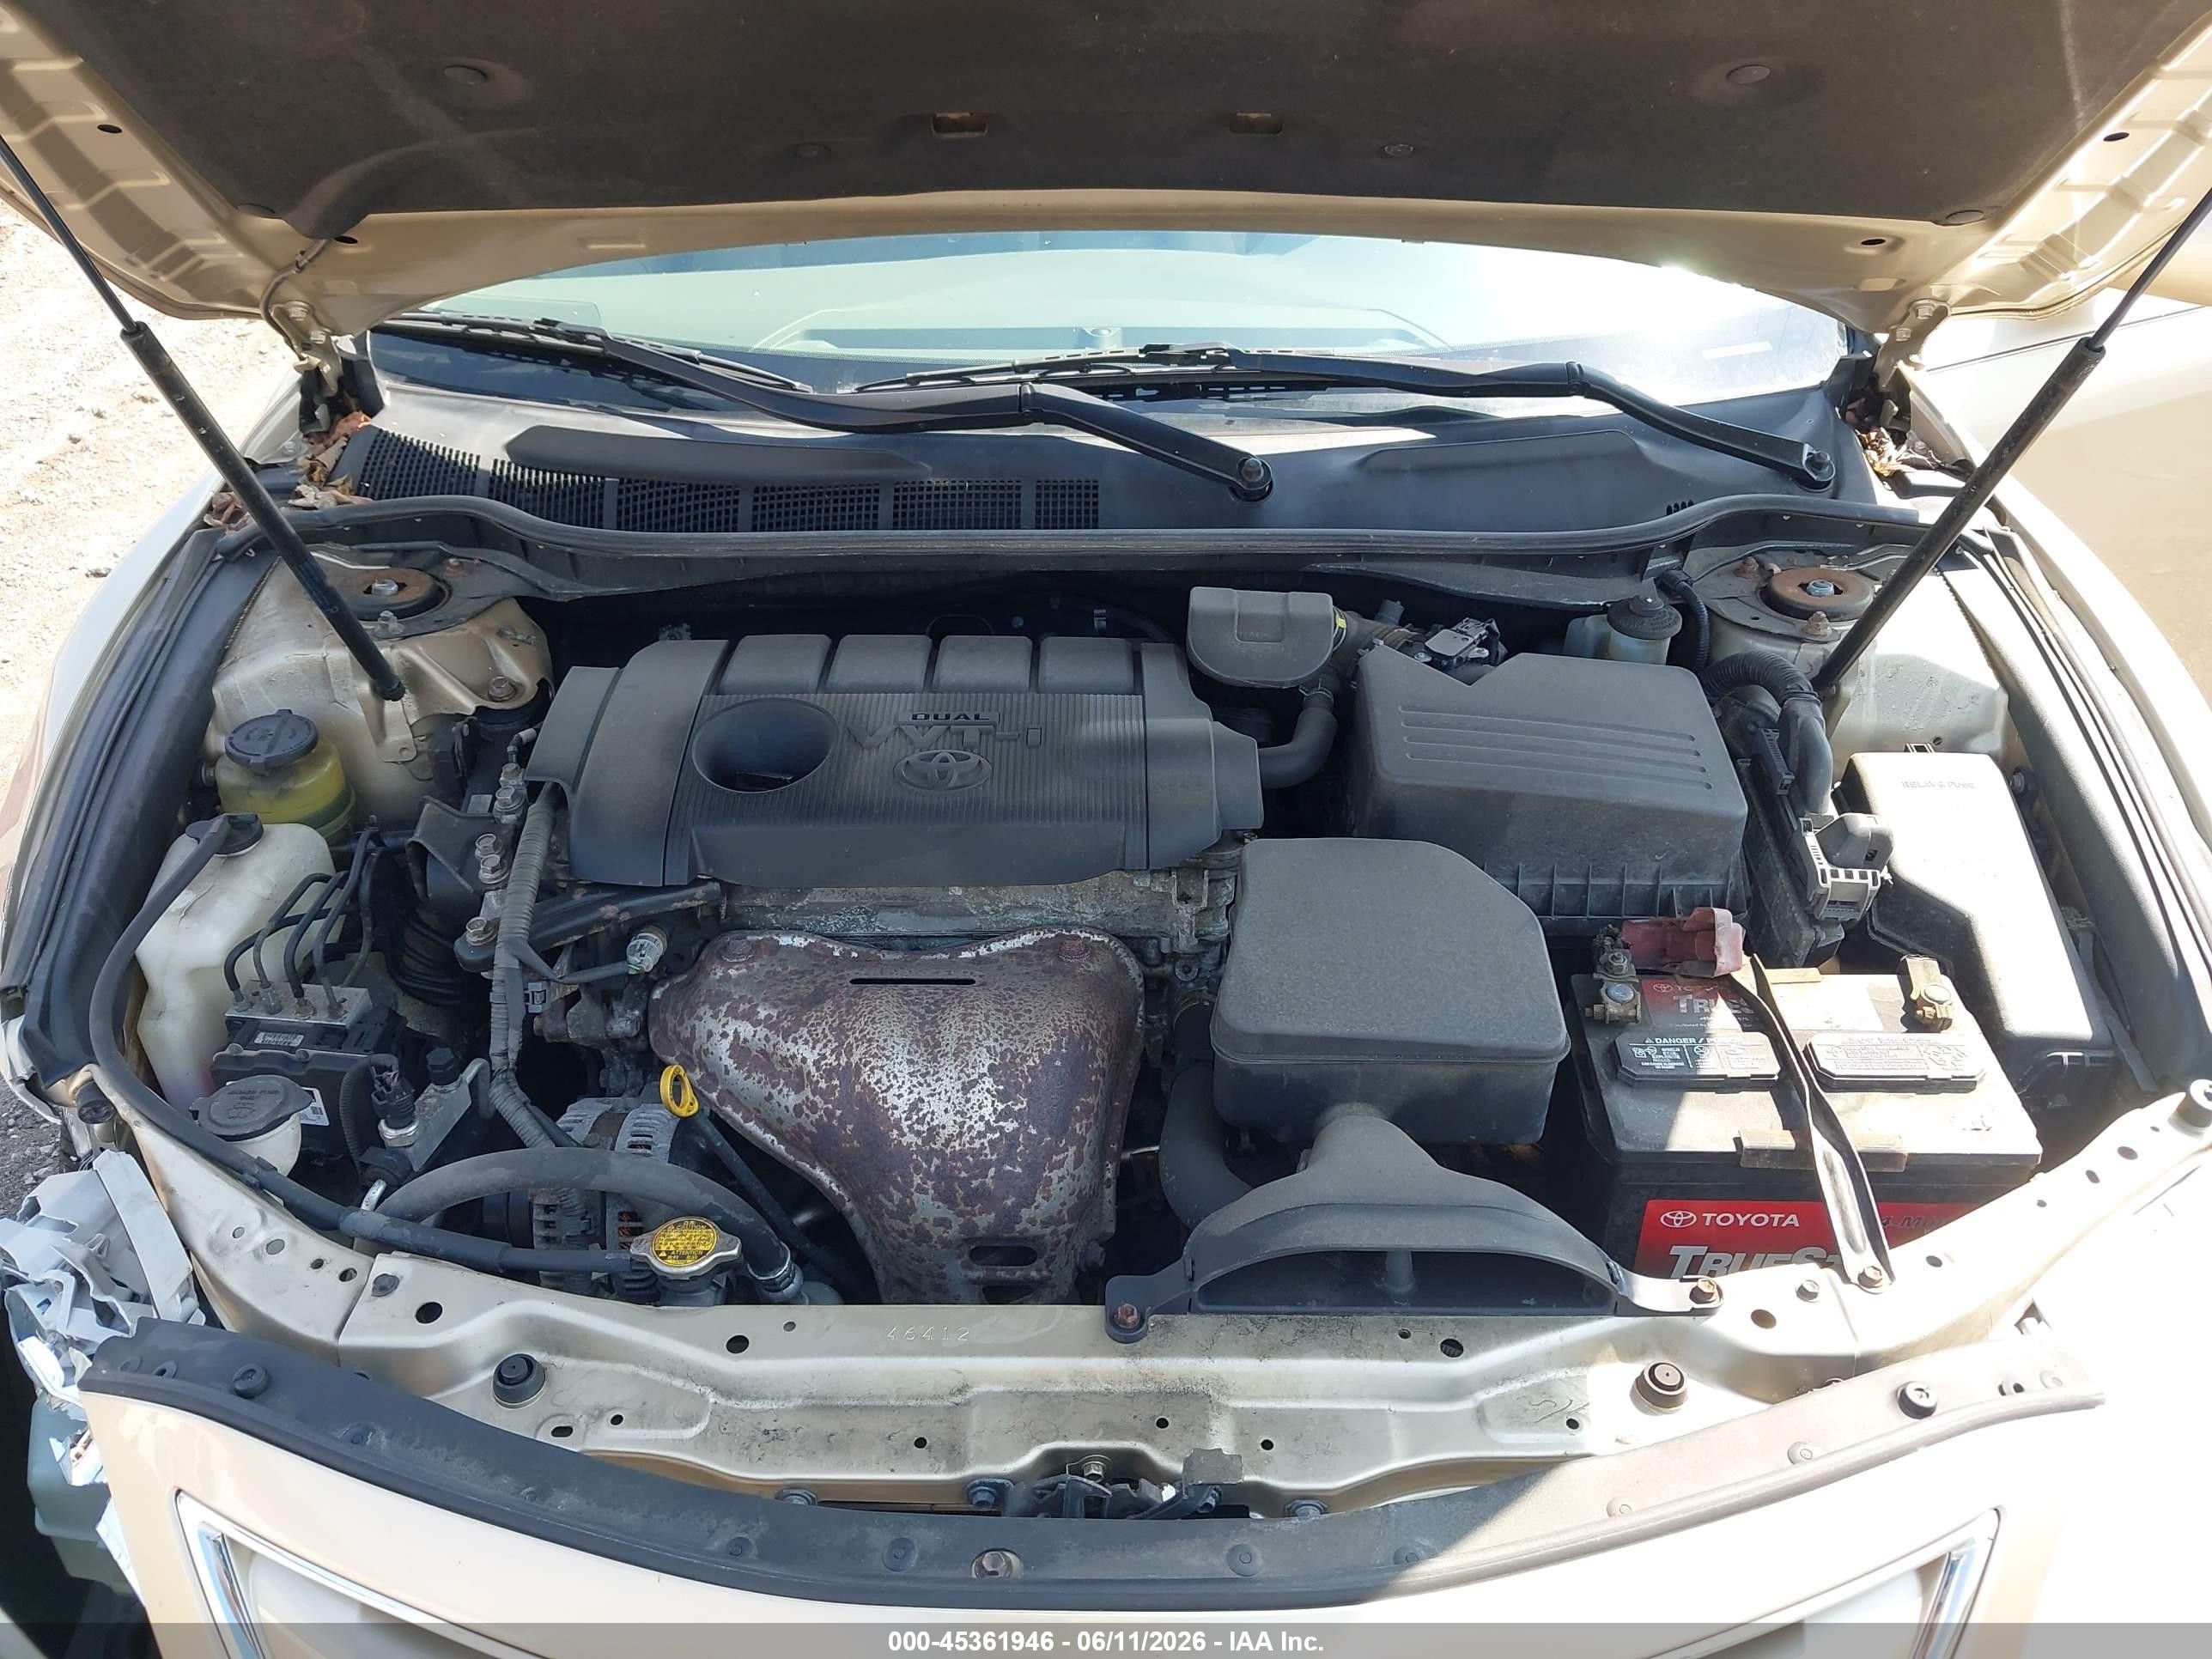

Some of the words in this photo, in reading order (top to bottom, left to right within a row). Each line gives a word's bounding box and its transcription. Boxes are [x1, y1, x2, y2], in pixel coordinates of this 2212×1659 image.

[911, 713, 990, 721] DUAL
[1701, 1212, 1801, 1228] TOYOTA
[886, 1326, 969, 1340] 46412
